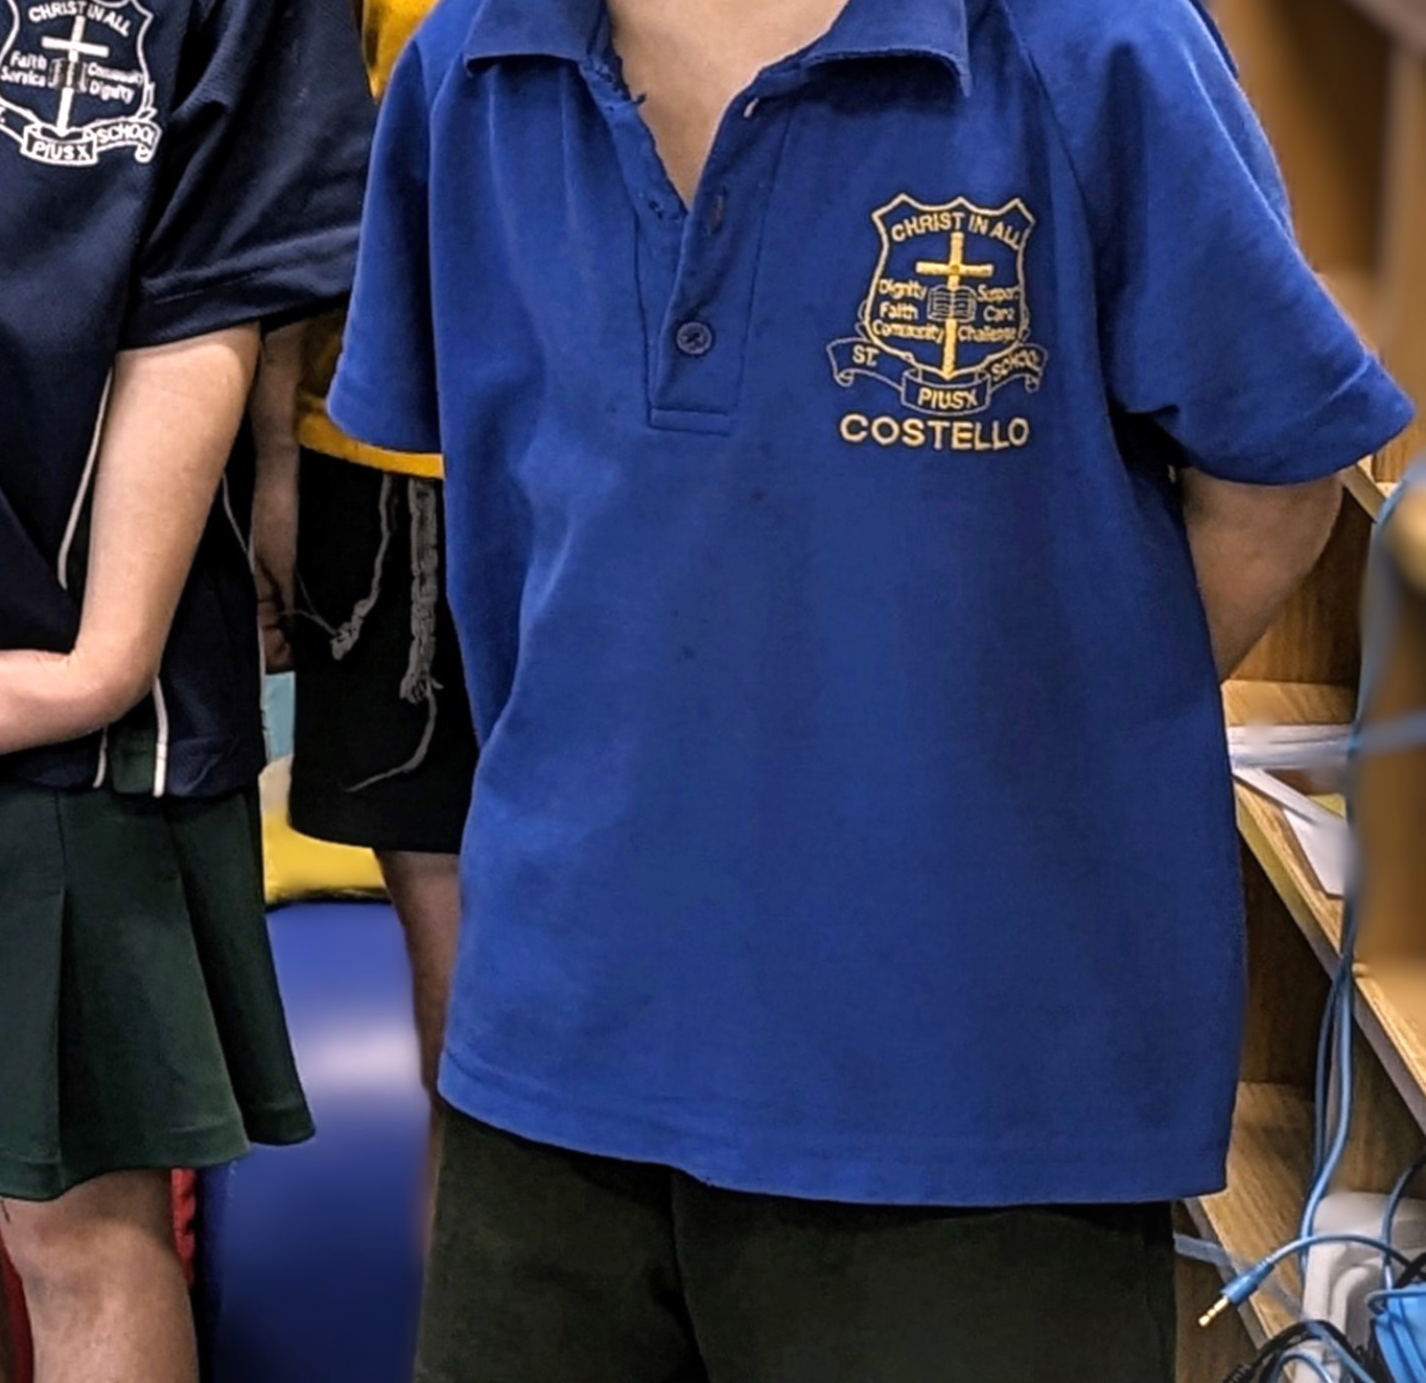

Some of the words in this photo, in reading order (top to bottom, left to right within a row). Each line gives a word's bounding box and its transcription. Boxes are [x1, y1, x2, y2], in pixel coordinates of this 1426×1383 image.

[27, 0, 87, 23] CHRIST
[87, 5, 105, 22] IN
[102, 14, 132, 38] ALL
[9, 50, 48, 70] Faith
[0, 65, 46, 88] Service
[89, 79, 135, 105] Dignity
[96, 122, 156, 144] SCHOOL
[891, 212, 966, 242] CHRIST
[968, 215, 989, 236] IN
[989, 224, 1021, 251] ALL
[878, 278, 928, 301] Dignity
[879, 301, 919, 320] Faith
[839, 413, 1031, 451] COSTELLO
